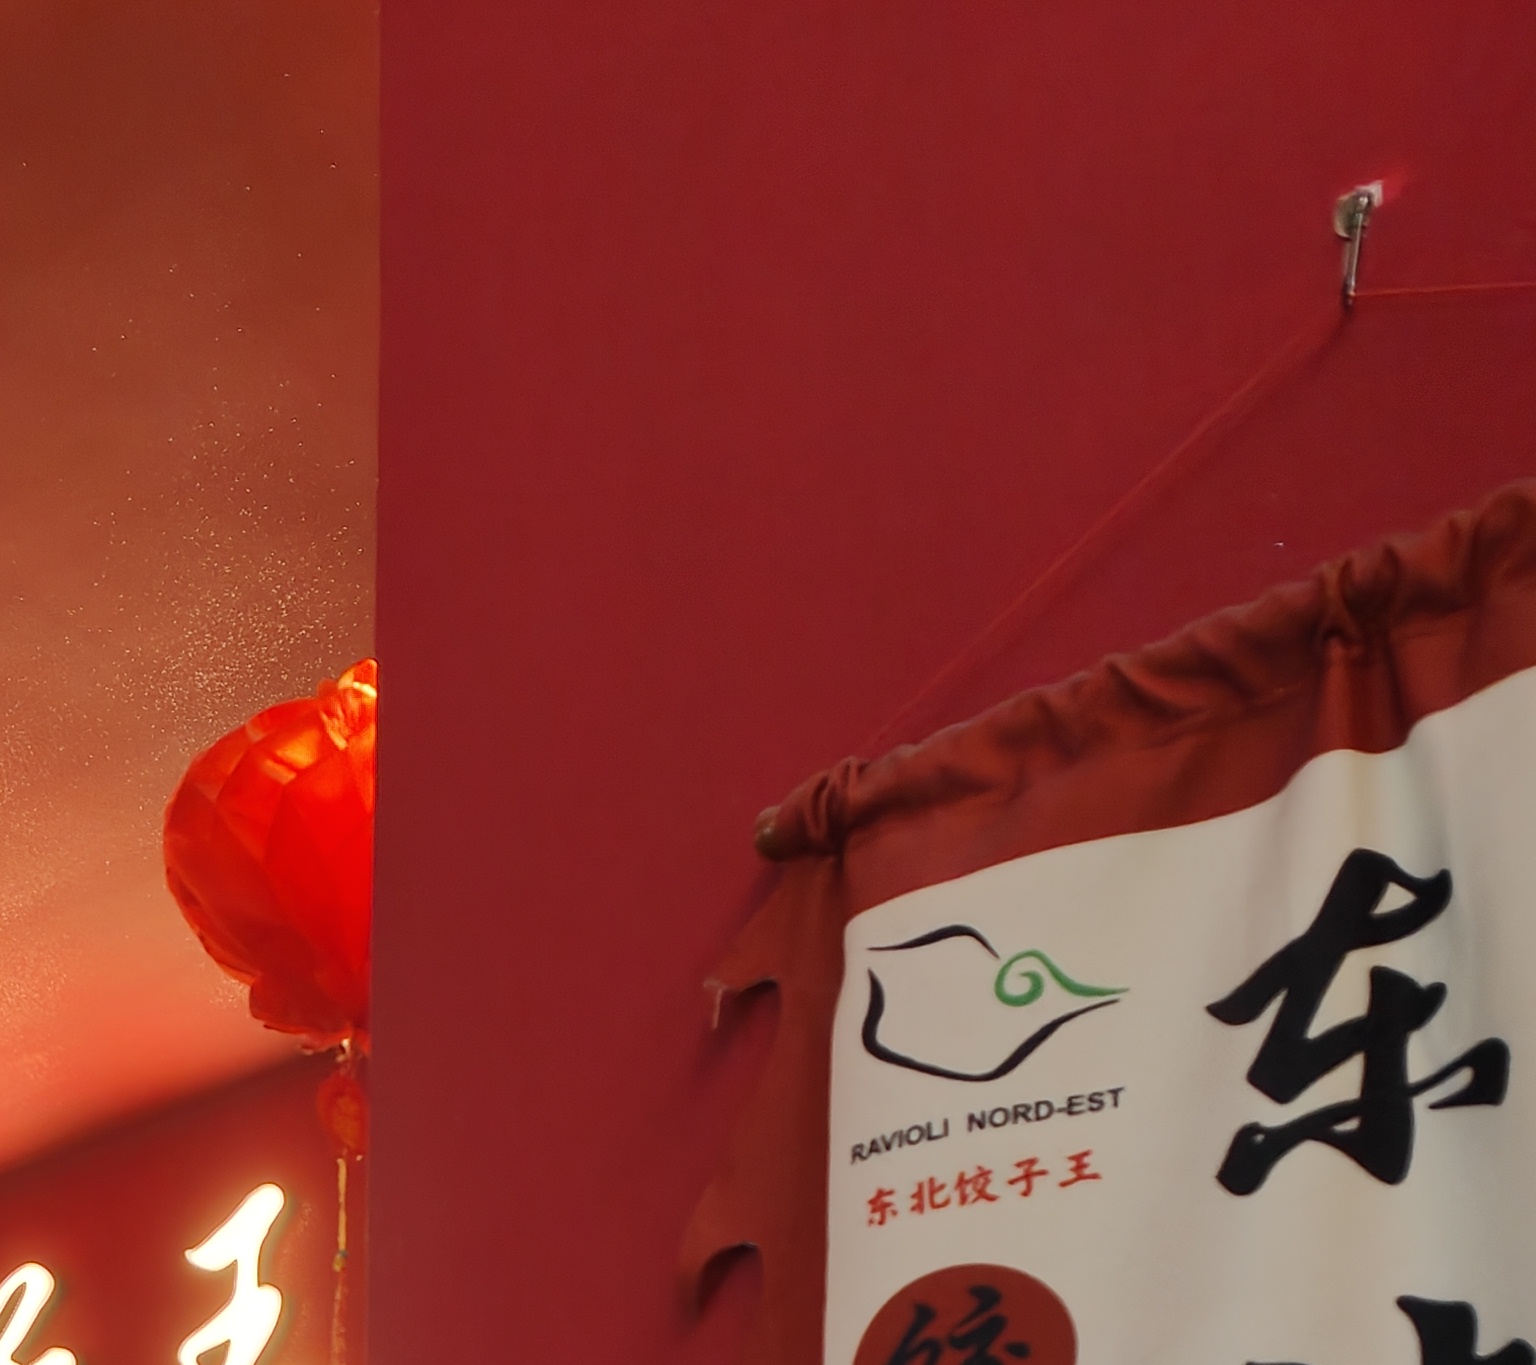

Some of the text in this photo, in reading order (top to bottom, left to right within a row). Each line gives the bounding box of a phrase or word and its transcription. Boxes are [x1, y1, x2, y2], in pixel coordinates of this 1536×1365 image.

[850, 1087, 1124, 1164] RAVIOLI NORD-EST
[867, 1149, 1102, 1226] 东北饺子王
